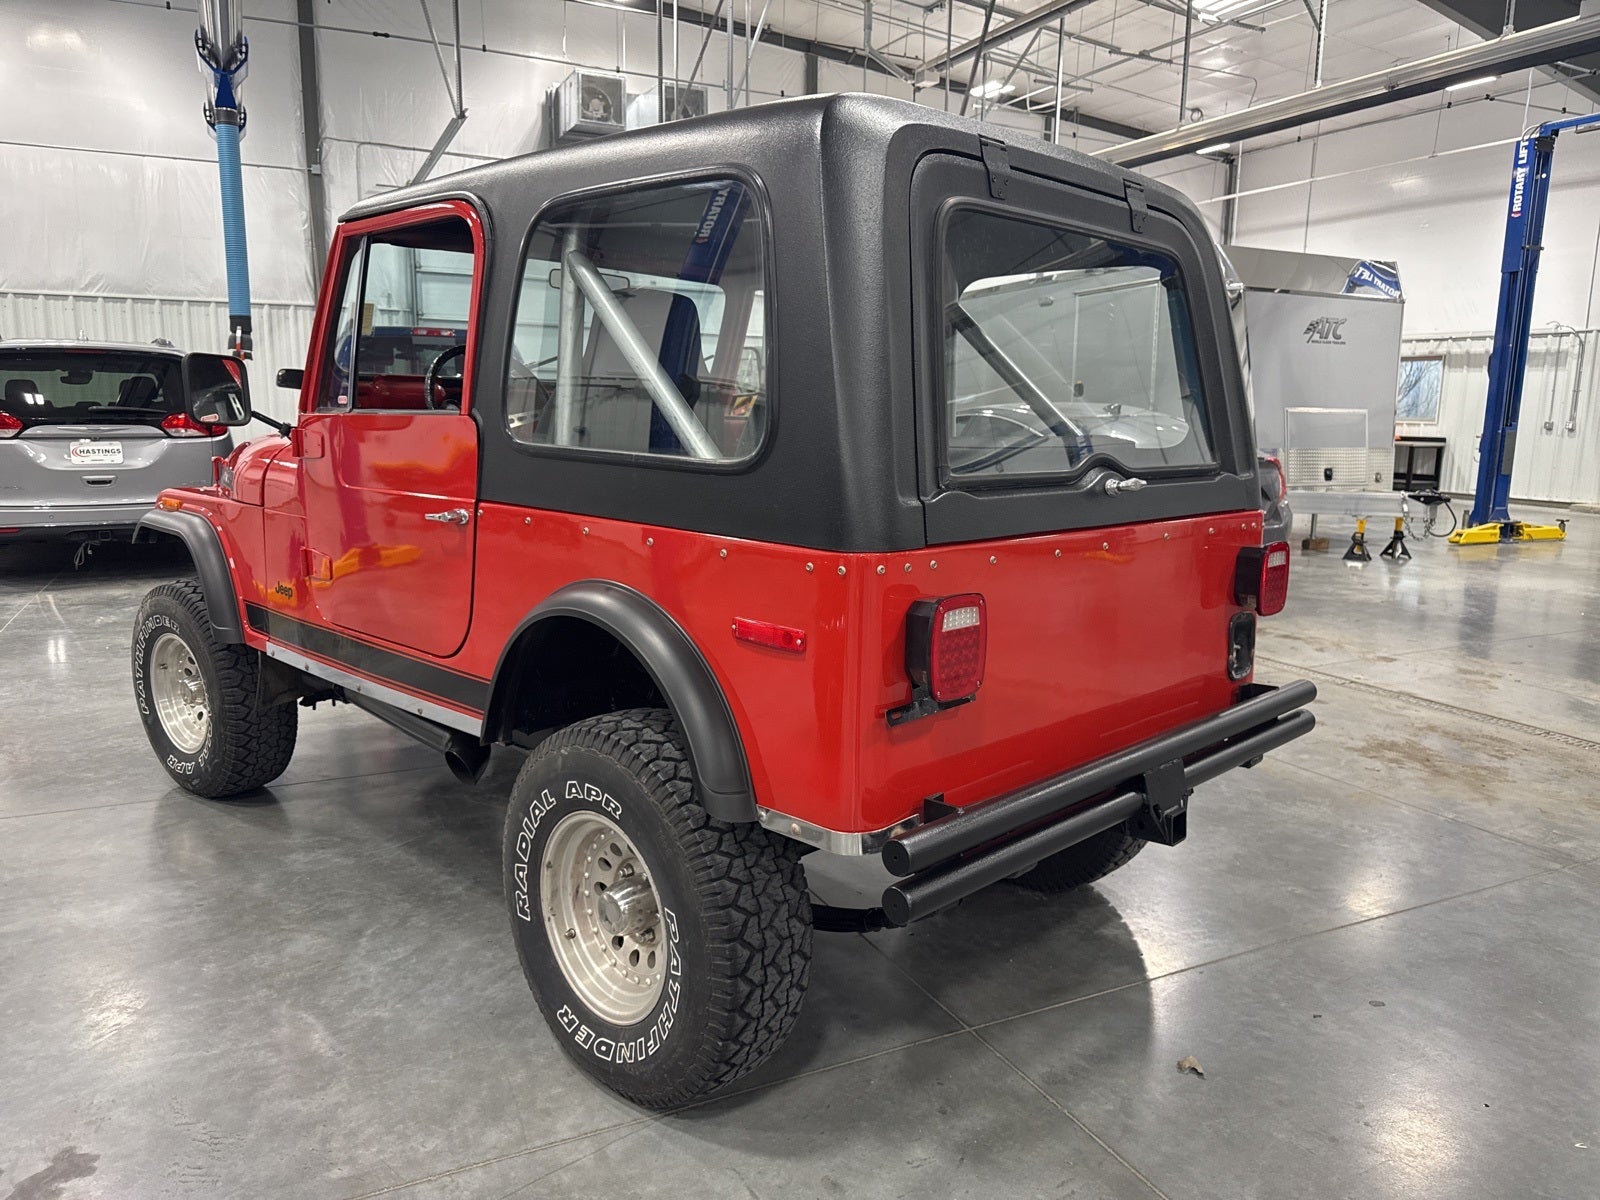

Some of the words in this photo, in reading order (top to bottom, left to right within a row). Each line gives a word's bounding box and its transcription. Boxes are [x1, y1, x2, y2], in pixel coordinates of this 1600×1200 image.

[1518, 138, 1529, 165] LIFT
[1512, 167, 1525, 212] ROTARY
[1316, 316, 1347, 340] ATC
[274, 580, 293, 600] Jeep
[135, 614, 180, 715] PATHFINDER
[166, 753, 195, 775] APR
[513, 788, 557, 922] RADIAL
[565, 780, 623, 820] APR
[556, 906, 682, 1064] PATHFINDER
